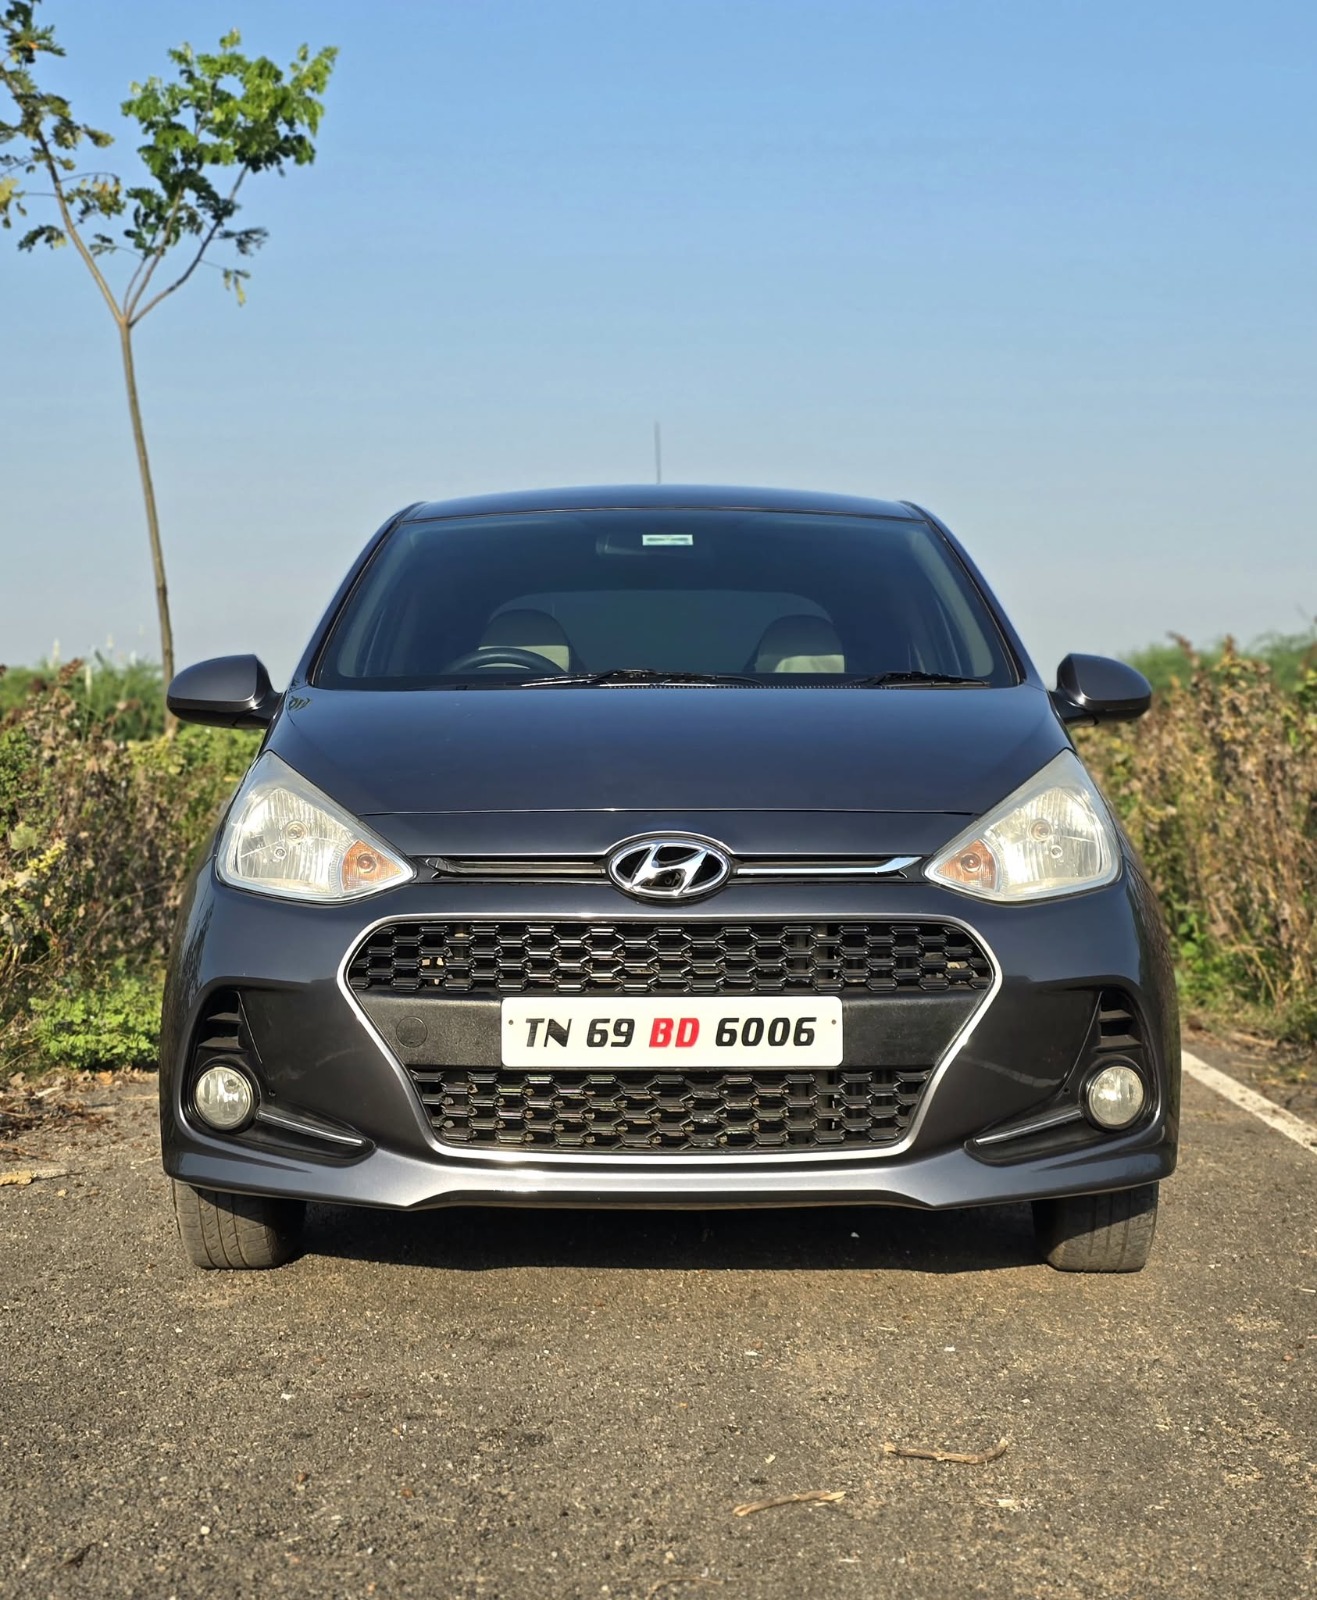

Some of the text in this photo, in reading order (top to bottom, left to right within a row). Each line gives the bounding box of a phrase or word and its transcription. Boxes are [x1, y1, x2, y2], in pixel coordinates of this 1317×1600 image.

[525, 1017, 817, 1048] TN 69 BD 6006
